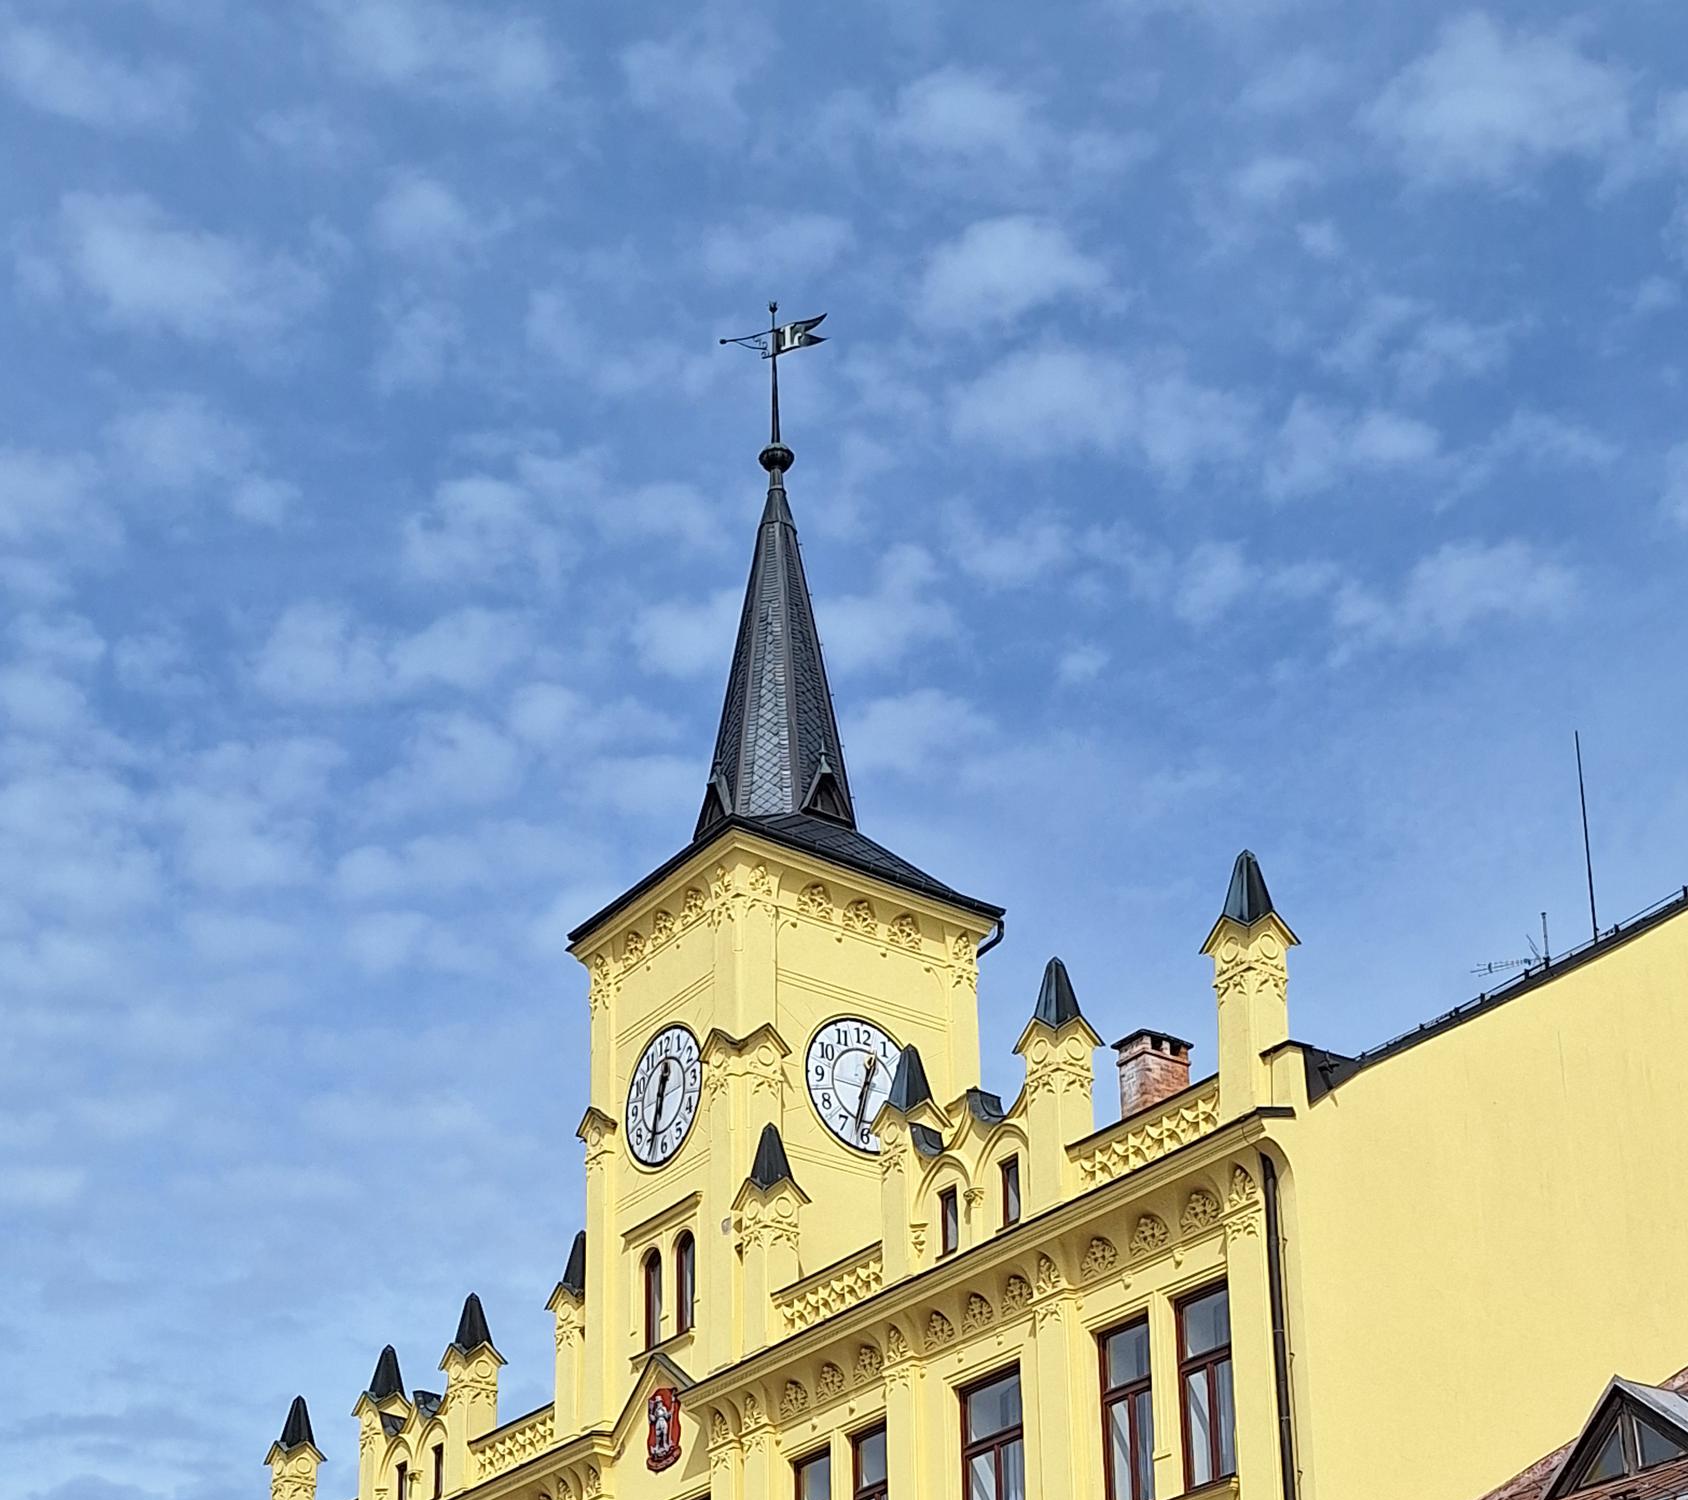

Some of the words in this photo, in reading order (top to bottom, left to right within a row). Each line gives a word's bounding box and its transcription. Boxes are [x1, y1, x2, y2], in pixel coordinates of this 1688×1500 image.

[675, 1034, 682, 1053] 1
[835, 1028, 849, 1047] 11
[854, 1027, 871, 1046] 12
[658, 1036, 670, 1057] 12
[686, 1045, 693, 1063] 2
[818, 1042, 834, 1061] 10
[880, 1041, 888, 1058] 1
[646, 1053, 654, 1072] 11
[690, 1068, 697, 1086] 3
[815, 1065, 824, 1082] 9
[635, 1077, 645, 1098] 10
[686, 1096, 692, 1114] 4
[821, 1092, 832, 1110] 8
[631, 1105, 638, 1123] 9
[838, 1114, 848, 1131] 7
[636, 1127, 642, 1146] 8
[675, 1121, 682, 1140] 5
[660, 1134, 667, 1154] 6
